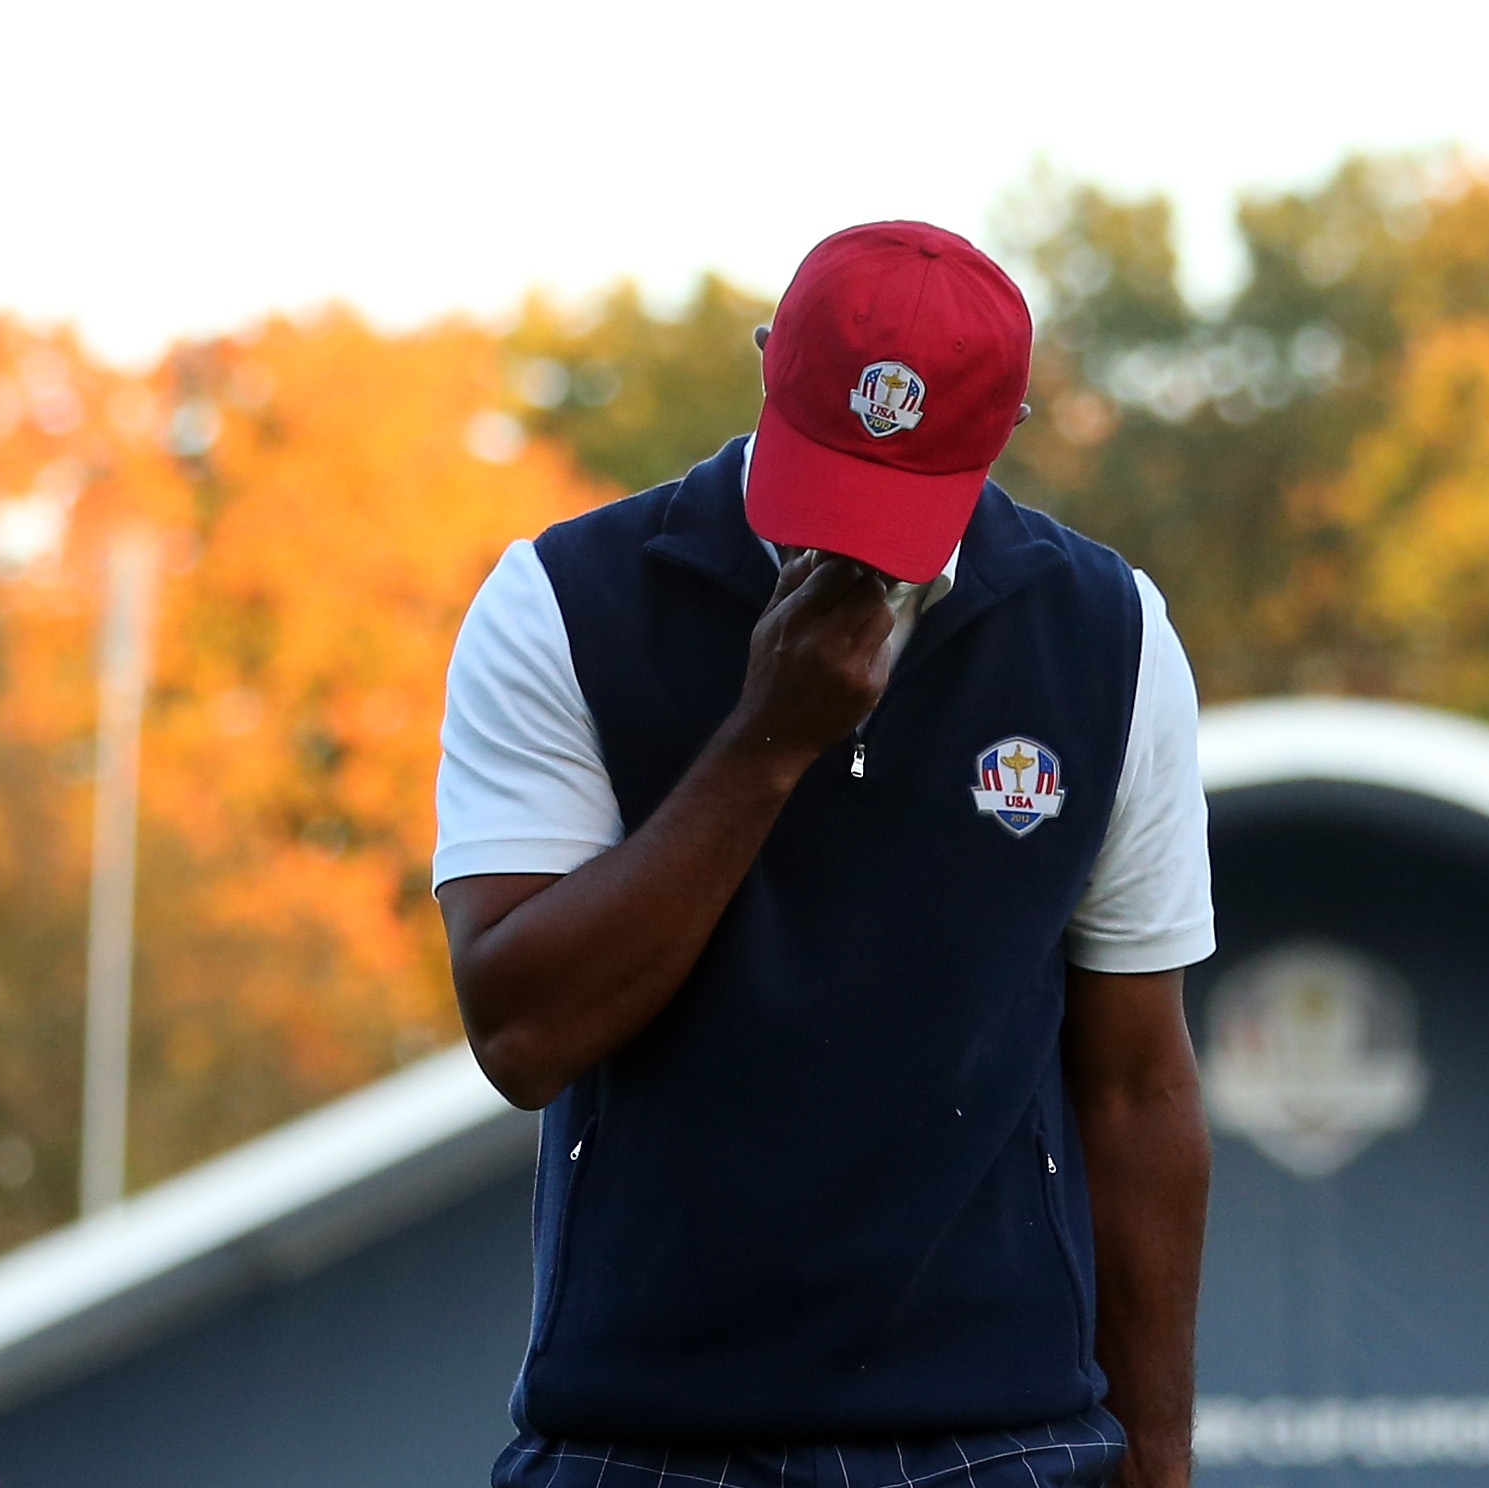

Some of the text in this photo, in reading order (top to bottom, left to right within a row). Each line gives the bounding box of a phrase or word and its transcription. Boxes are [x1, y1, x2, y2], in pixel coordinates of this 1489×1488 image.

[870, 403, 897, 421] USA
[868, 417, 891, 430] 2012
[1005, 795, 1033, 809] USA
[1010, 814, 1030, 823] 2012
